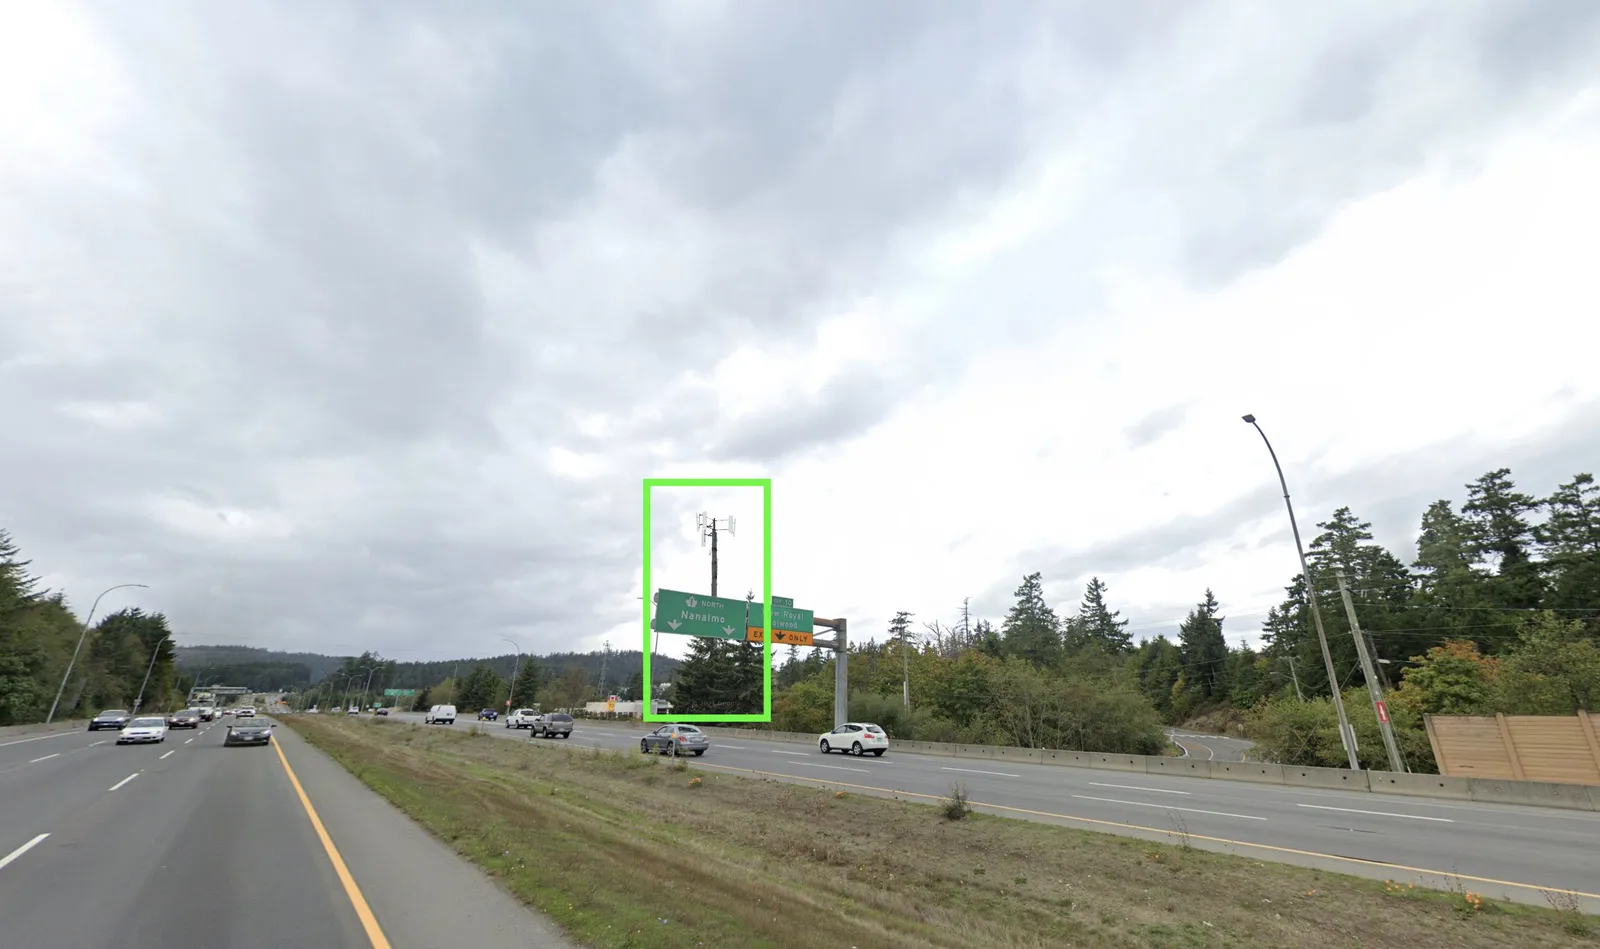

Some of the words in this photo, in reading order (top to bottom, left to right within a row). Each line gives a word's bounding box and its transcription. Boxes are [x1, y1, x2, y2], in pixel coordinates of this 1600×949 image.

[701, 600, 724, 609] NORTH
[681, 610, 725, 623] Nanaimo
[784, 611, 804, 621] Royal
[772, 619, 797, 628] olwood
[789, 633, 808, 642] ONLY
